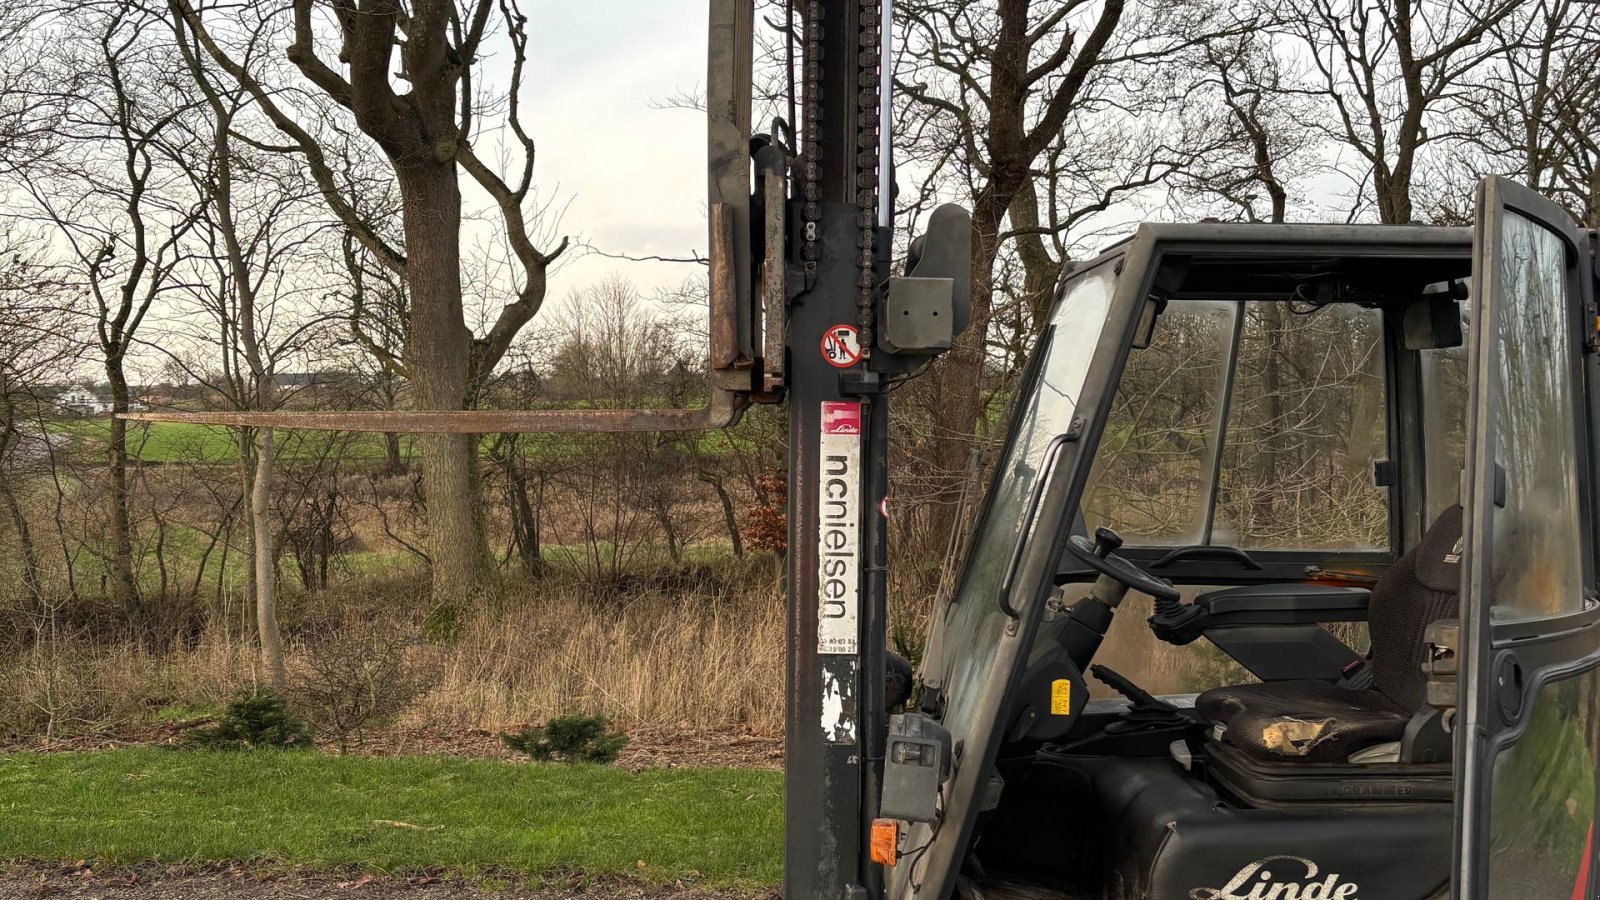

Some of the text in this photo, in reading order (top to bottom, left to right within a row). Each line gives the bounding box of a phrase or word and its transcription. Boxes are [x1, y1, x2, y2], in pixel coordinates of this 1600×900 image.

[830, 424, 859, 433] Linde
[824, 455, 854, 618] ncnielsen
[1187, 855, 1358, 900] Linde
